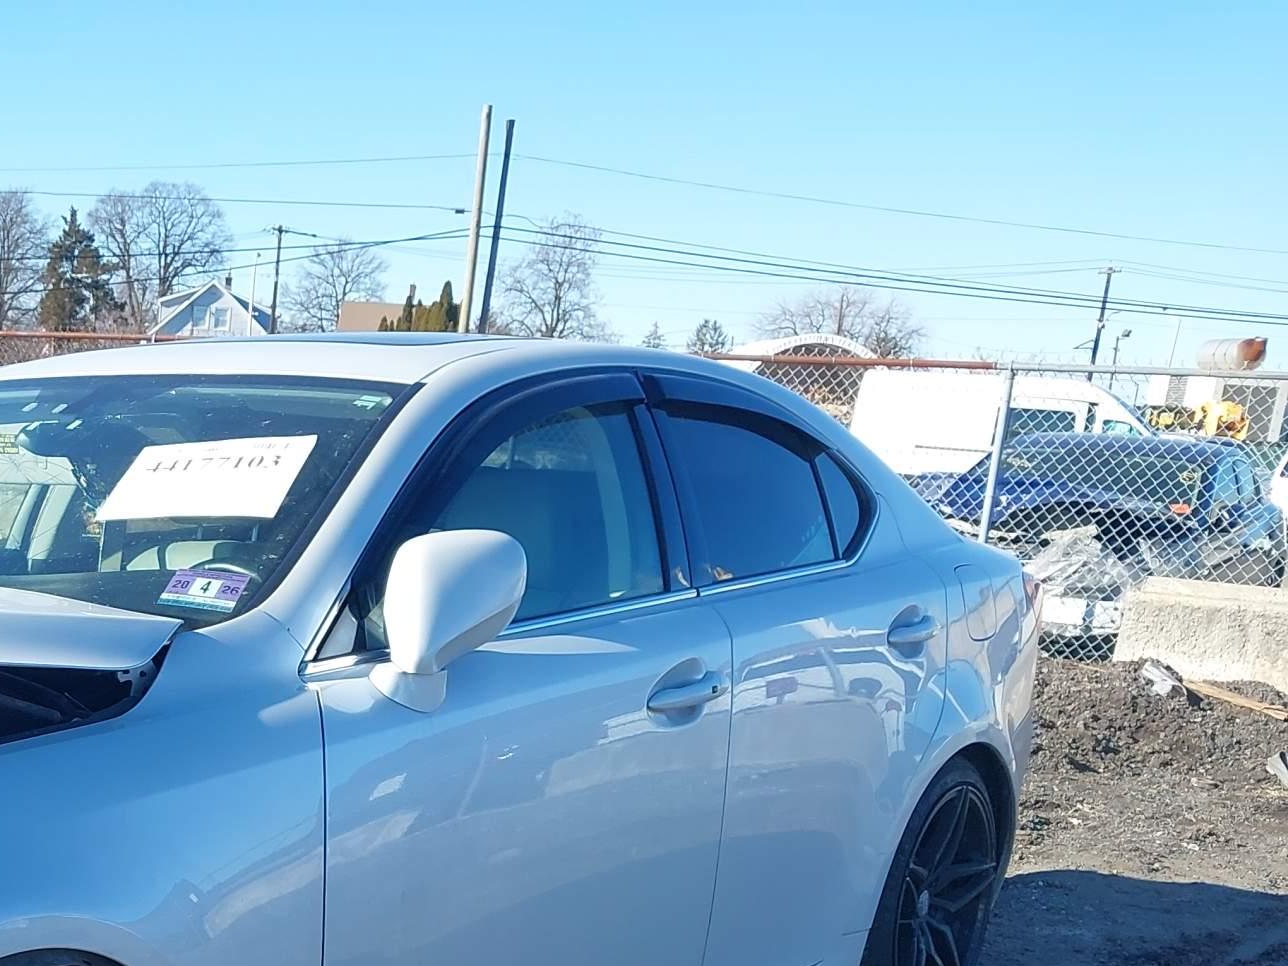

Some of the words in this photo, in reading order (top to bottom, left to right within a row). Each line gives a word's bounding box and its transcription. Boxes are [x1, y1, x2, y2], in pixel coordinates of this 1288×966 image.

[145, 455, 282, 473] 44177103
[172, 579, 190, 590] 20
[200, 580, 212, 594] 4
[222, 585, 241, 596] 26
